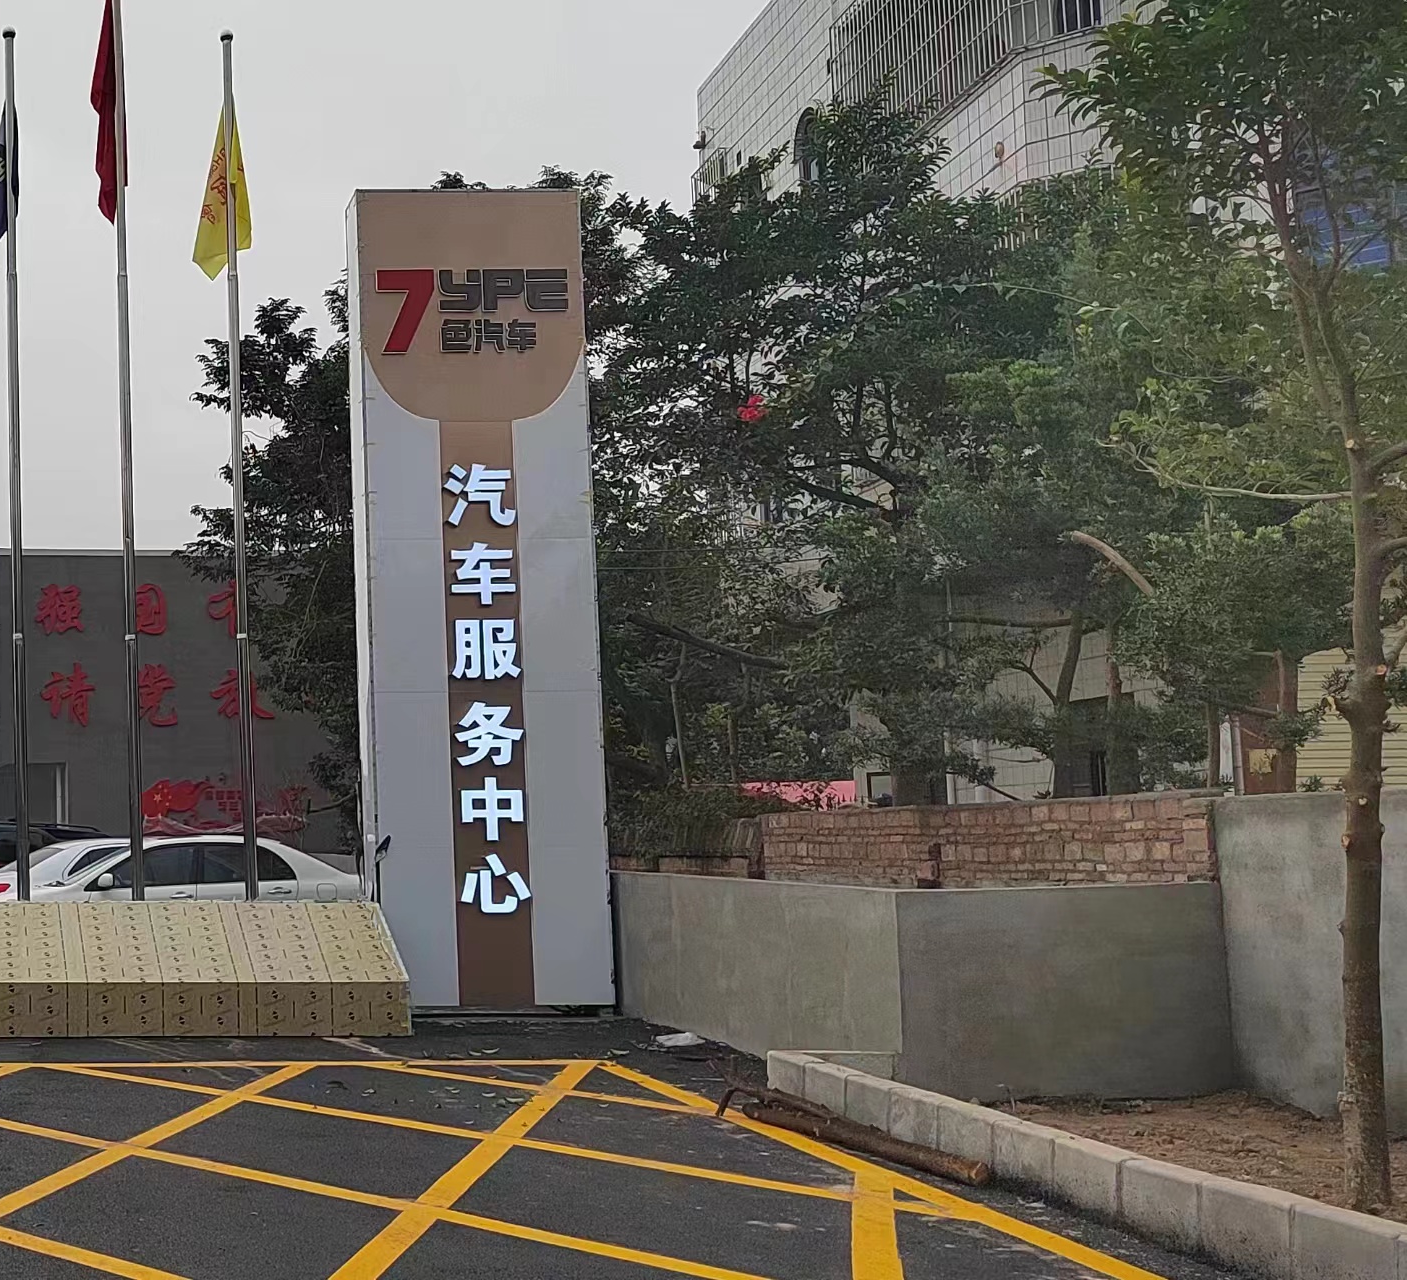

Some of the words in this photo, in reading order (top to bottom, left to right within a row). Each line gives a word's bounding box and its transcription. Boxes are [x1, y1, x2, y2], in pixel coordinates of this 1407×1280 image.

[440, 318, 537, 354] 色汽车
[443, 463, 532, 914] 汽车服务中心
